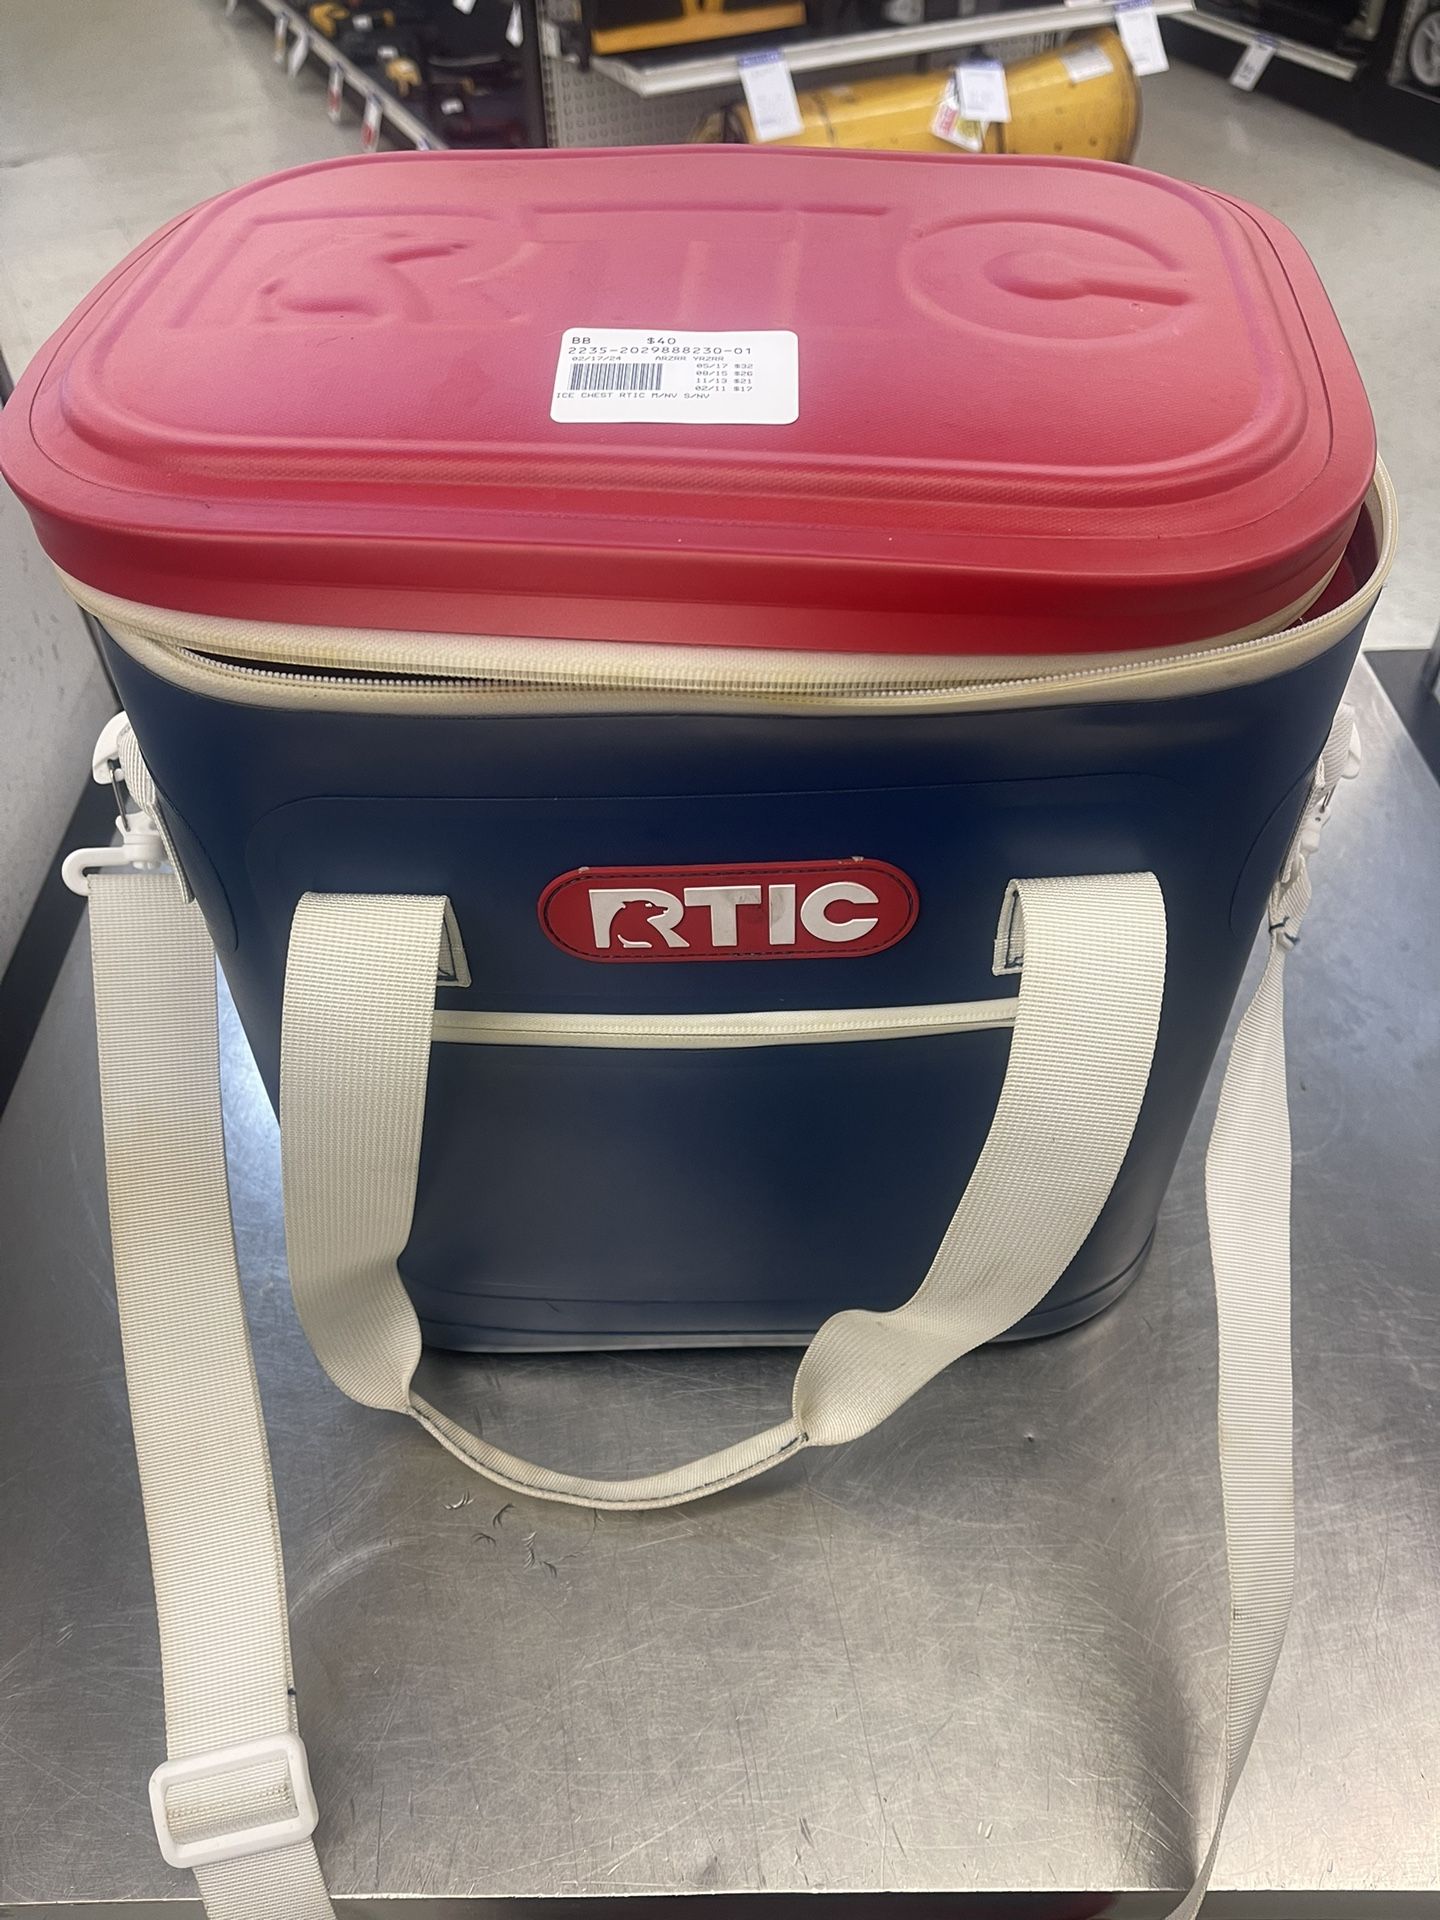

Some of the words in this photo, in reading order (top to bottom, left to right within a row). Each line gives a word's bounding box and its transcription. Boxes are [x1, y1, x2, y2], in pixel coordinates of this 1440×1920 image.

[571, 336, 592, 345] BB
[646, 336, 677, 345] $40
[568, 346, 752, 355] 2235-2029888230-01
[587, 881, 880, 949] RTIC
